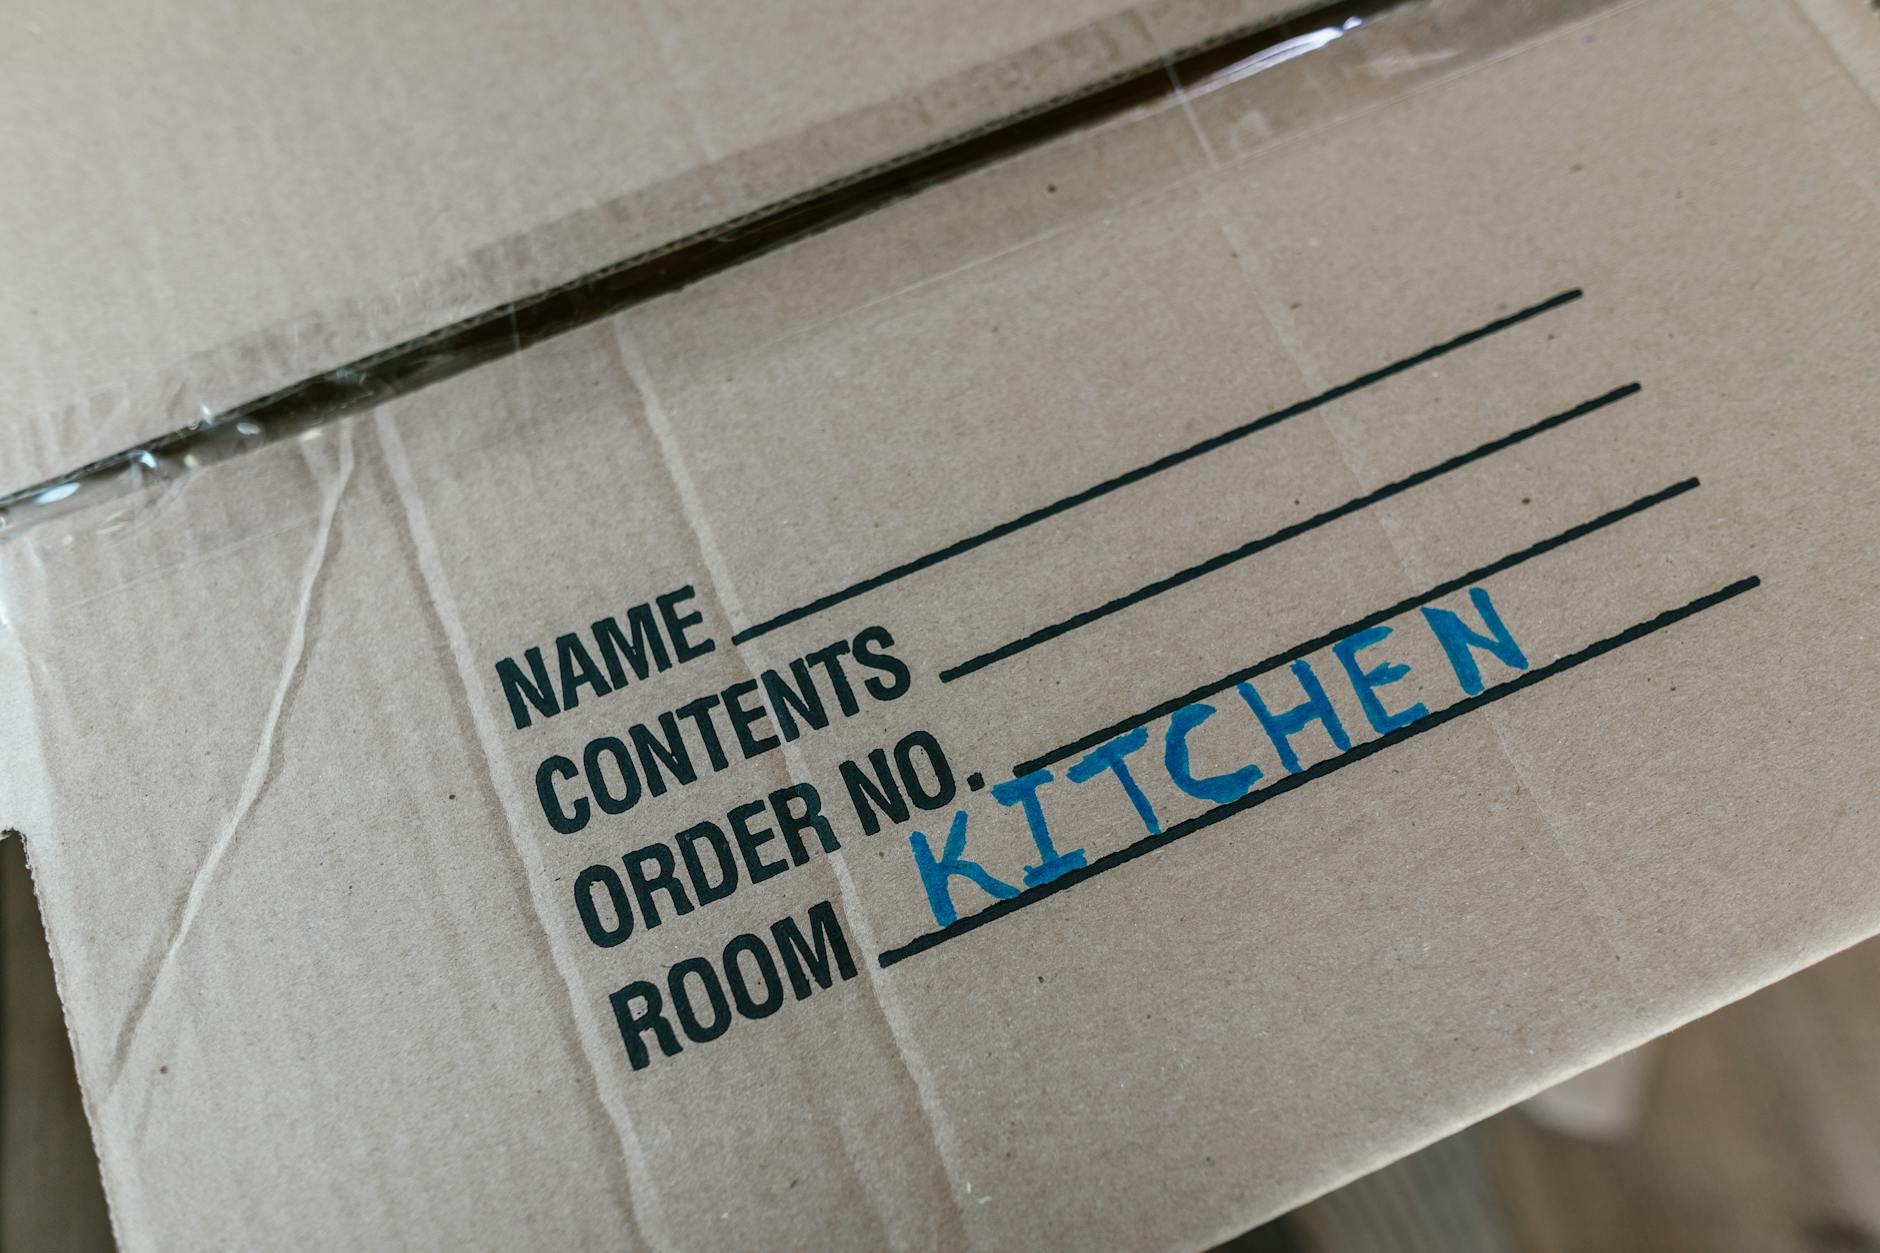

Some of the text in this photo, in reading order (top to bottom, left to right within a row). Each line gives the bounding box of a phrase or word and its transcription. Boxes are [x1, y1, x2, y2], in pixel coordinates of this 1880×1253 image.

[494, 584, 716, 731] NAME
[535, 625, 912, 835] CONTENTS
[908, 587, 1529, 929] KITCHEN
[573, 730, 986, 949] ORDER NO.
[608, 899, 859, 1072] ROOM
